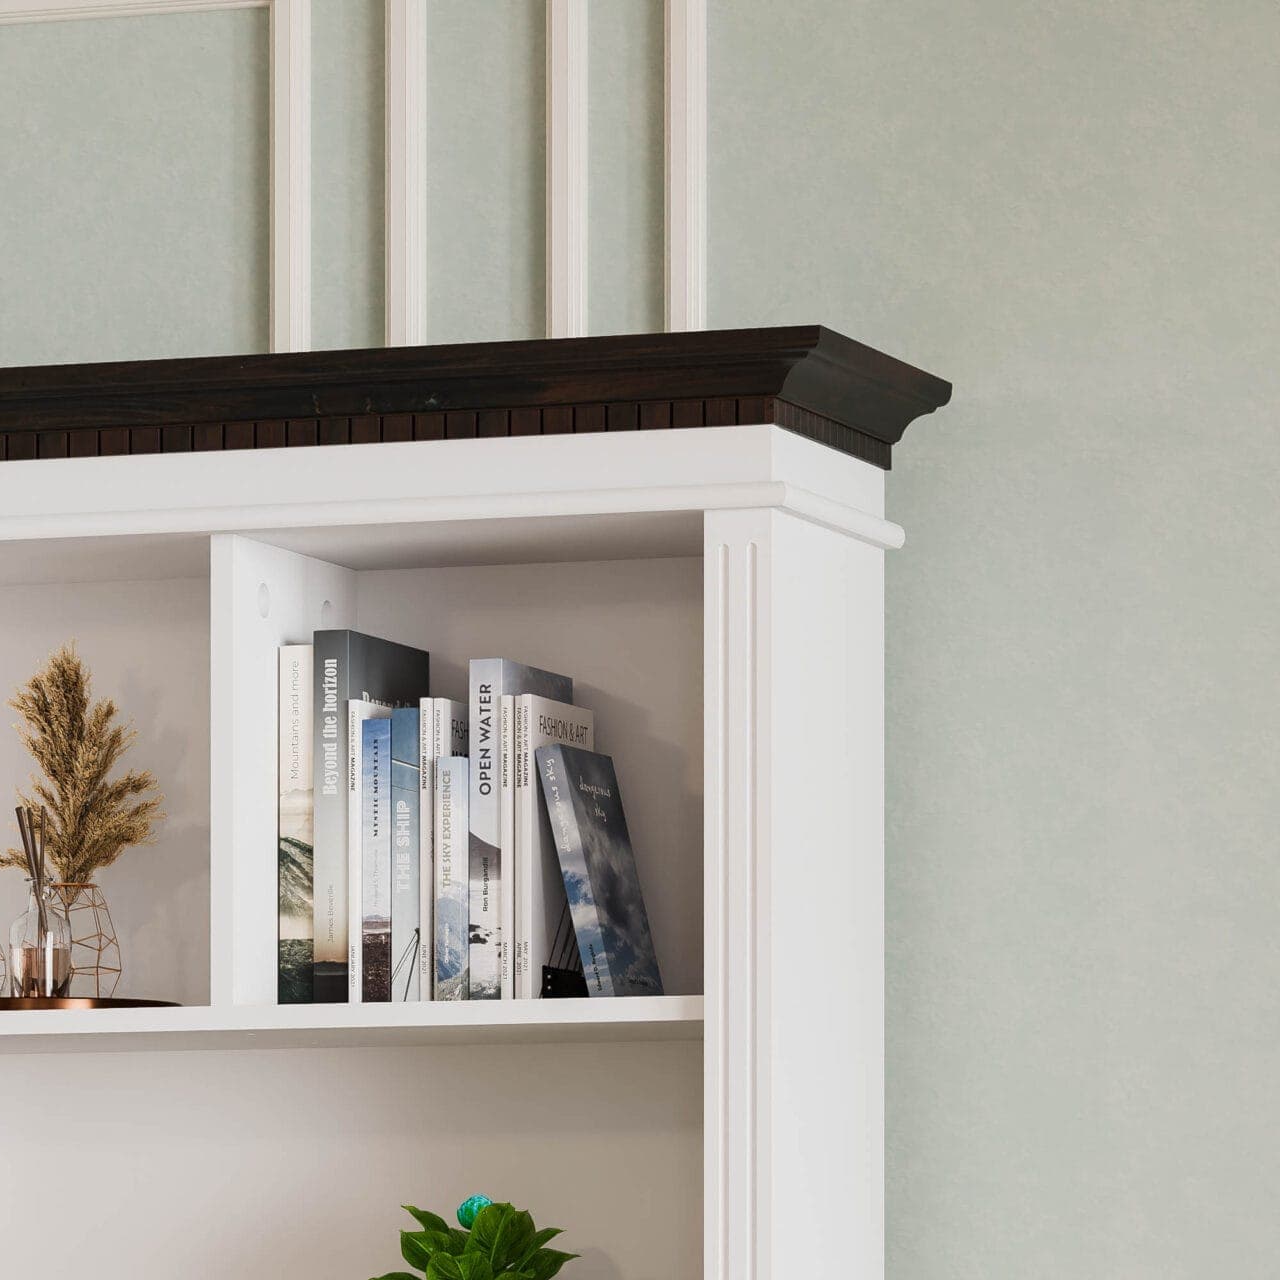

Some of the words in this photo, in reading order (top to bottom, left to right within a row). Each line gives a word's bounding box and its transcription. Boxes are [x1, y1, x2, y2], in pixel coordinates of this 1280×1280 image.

[291, 661, 299, 691] more
[322, 658, 338, 712] horizon
[290, 694, 299, 716] and
[479, 684, 492, 745] WATER
[322, 715, 338, 738] the
[539, 715, 568, 739] FASHION
[569, 722, 574, 742] &
[575, 724, 588, 744] ART
[290, 720, 299, 780] Mountains
[322, 743, 339, 795] Beyond
[479, 749, 492, 795] OPEN
[545, 758, 556, 781] sky
[396, 800, 410, 847] SHIP
[442, 770, 451, 840] EXPERIENCE
[442, 842, 451, 863] SKY
[396, 853, 410, 891] THE
[442, 866, 451, 888] THE
